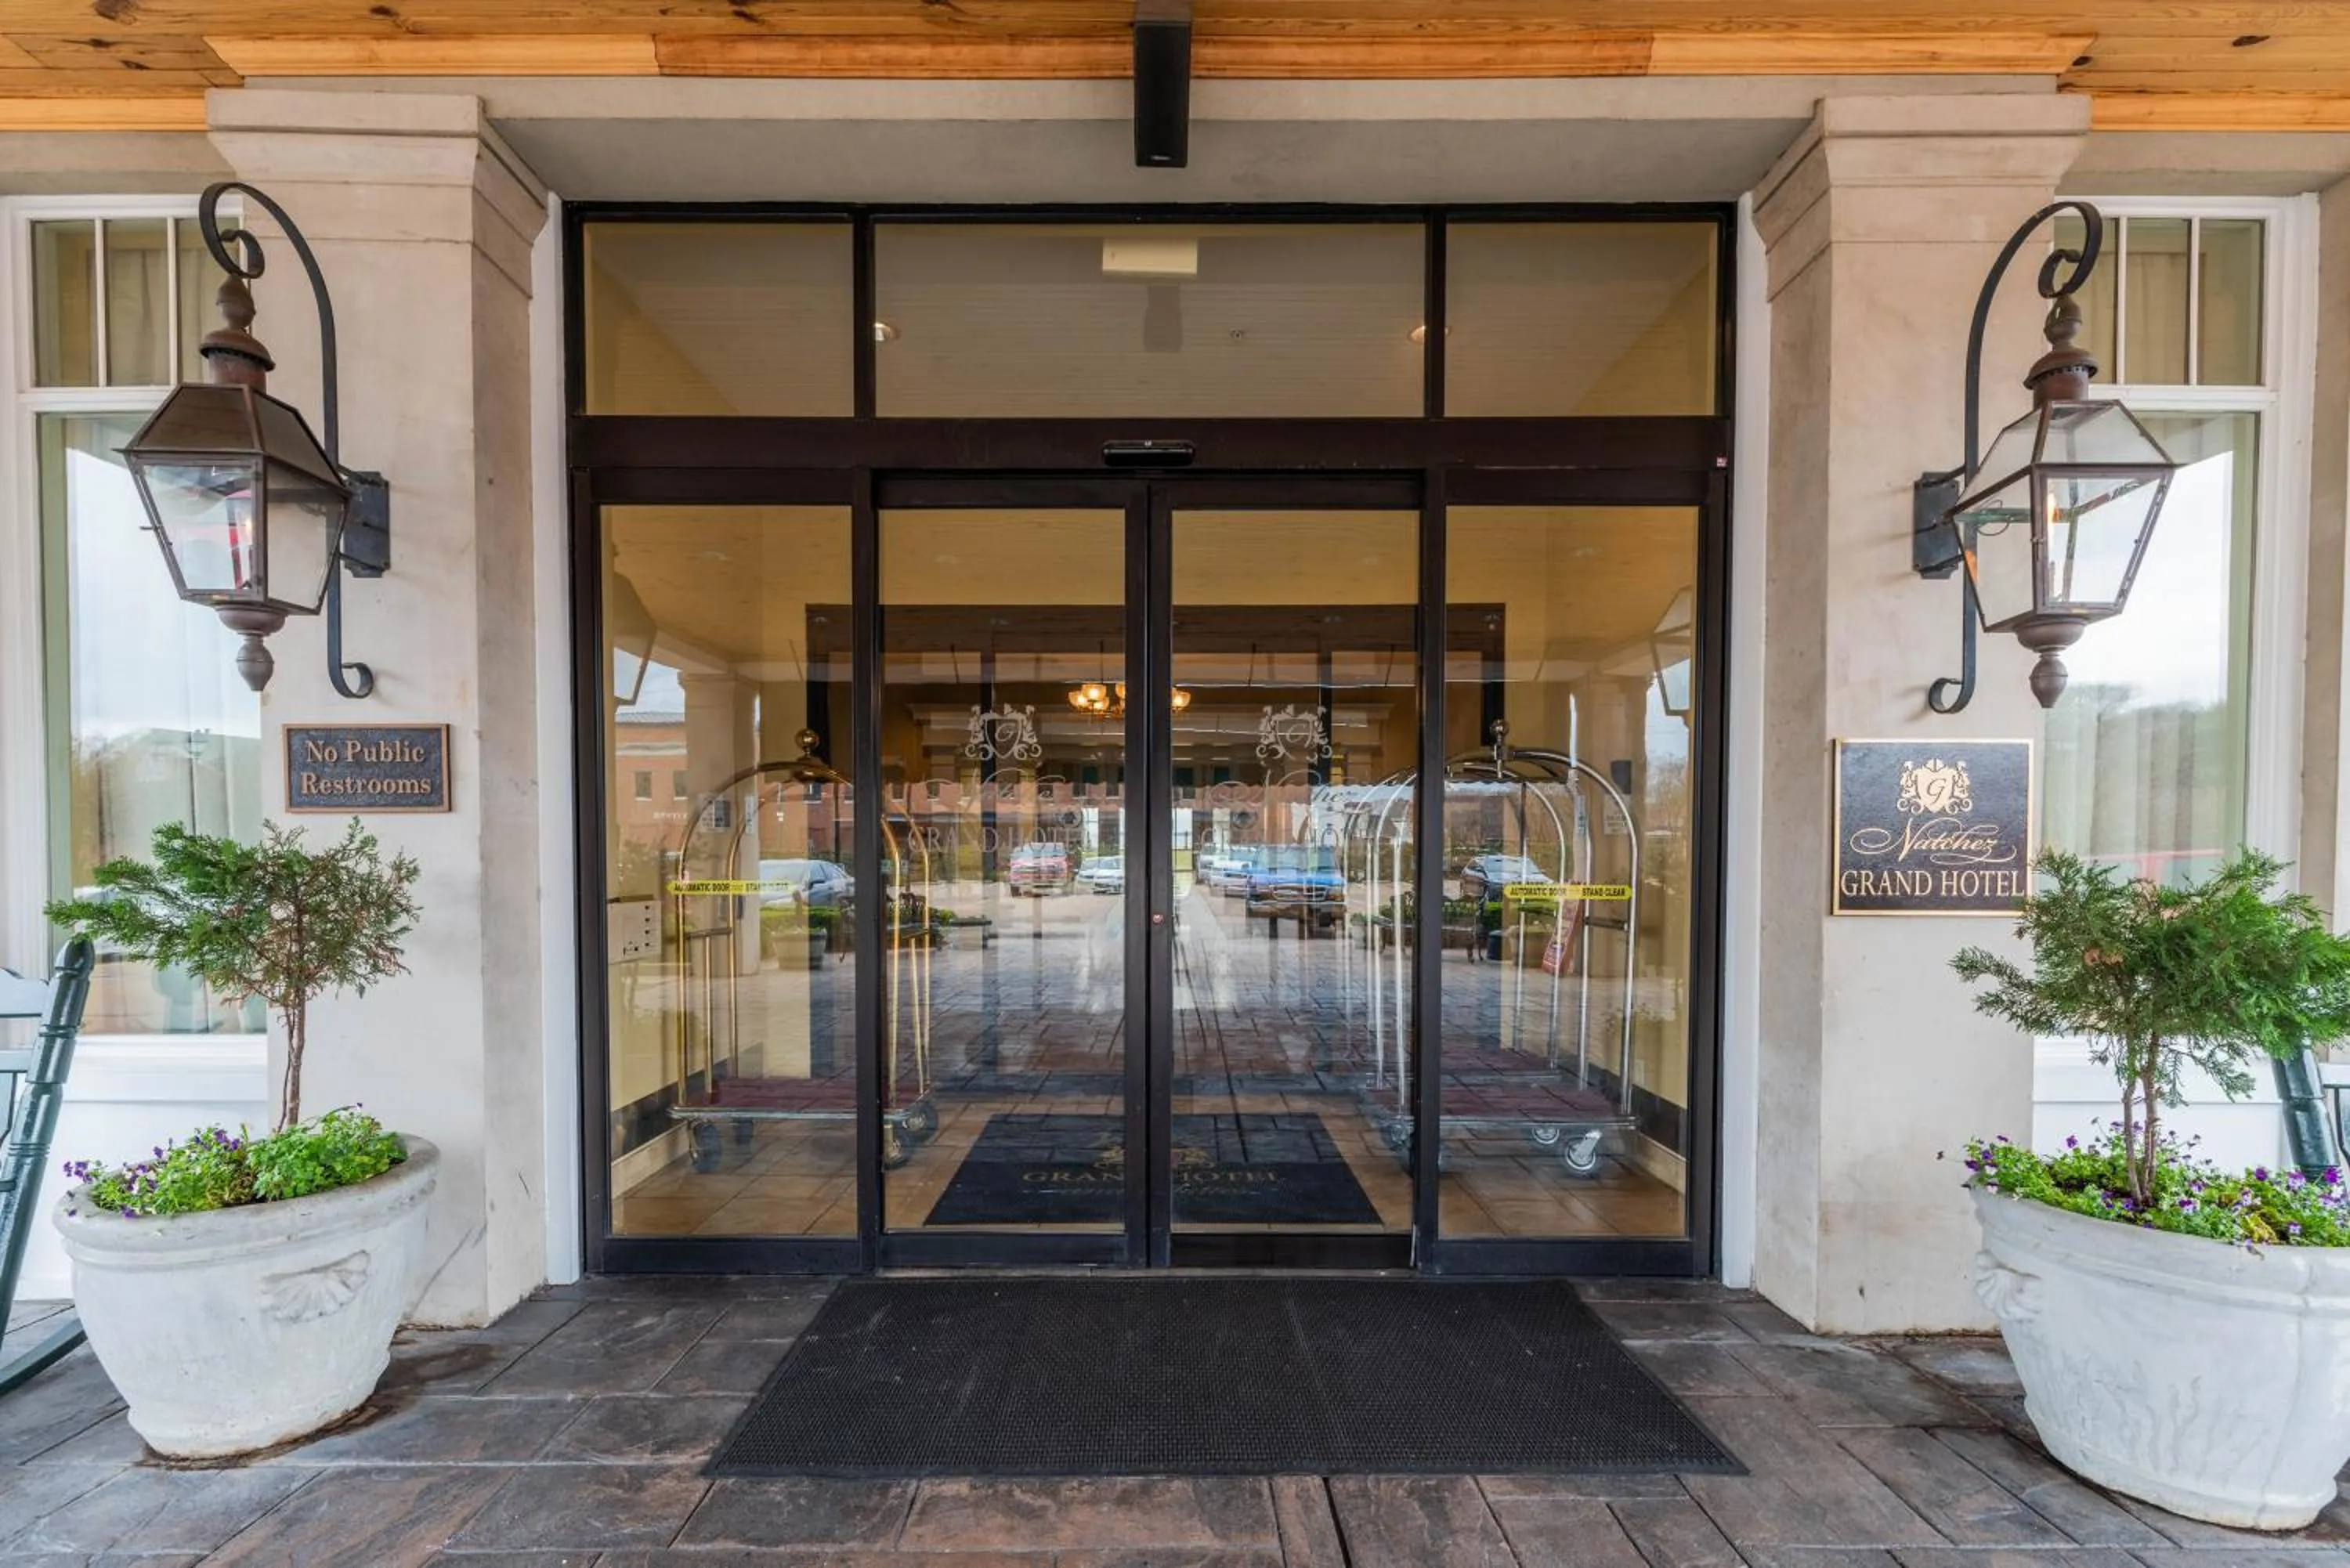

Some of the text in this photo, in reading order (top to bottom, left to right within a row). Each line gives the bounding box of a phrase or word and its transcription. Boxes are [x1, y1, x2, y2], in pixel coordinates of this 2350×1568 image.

[305, 740, 425, 762] No Public
[300, 772, 432, 794] Restrooms
[1926, 778, 1947, 805] G
[1849, 817, 2017, 865] Natchez
[1841, 870, 2025, 897] GRAND HOTEL
[1021, 1171, 1126, 1183] GRAN
